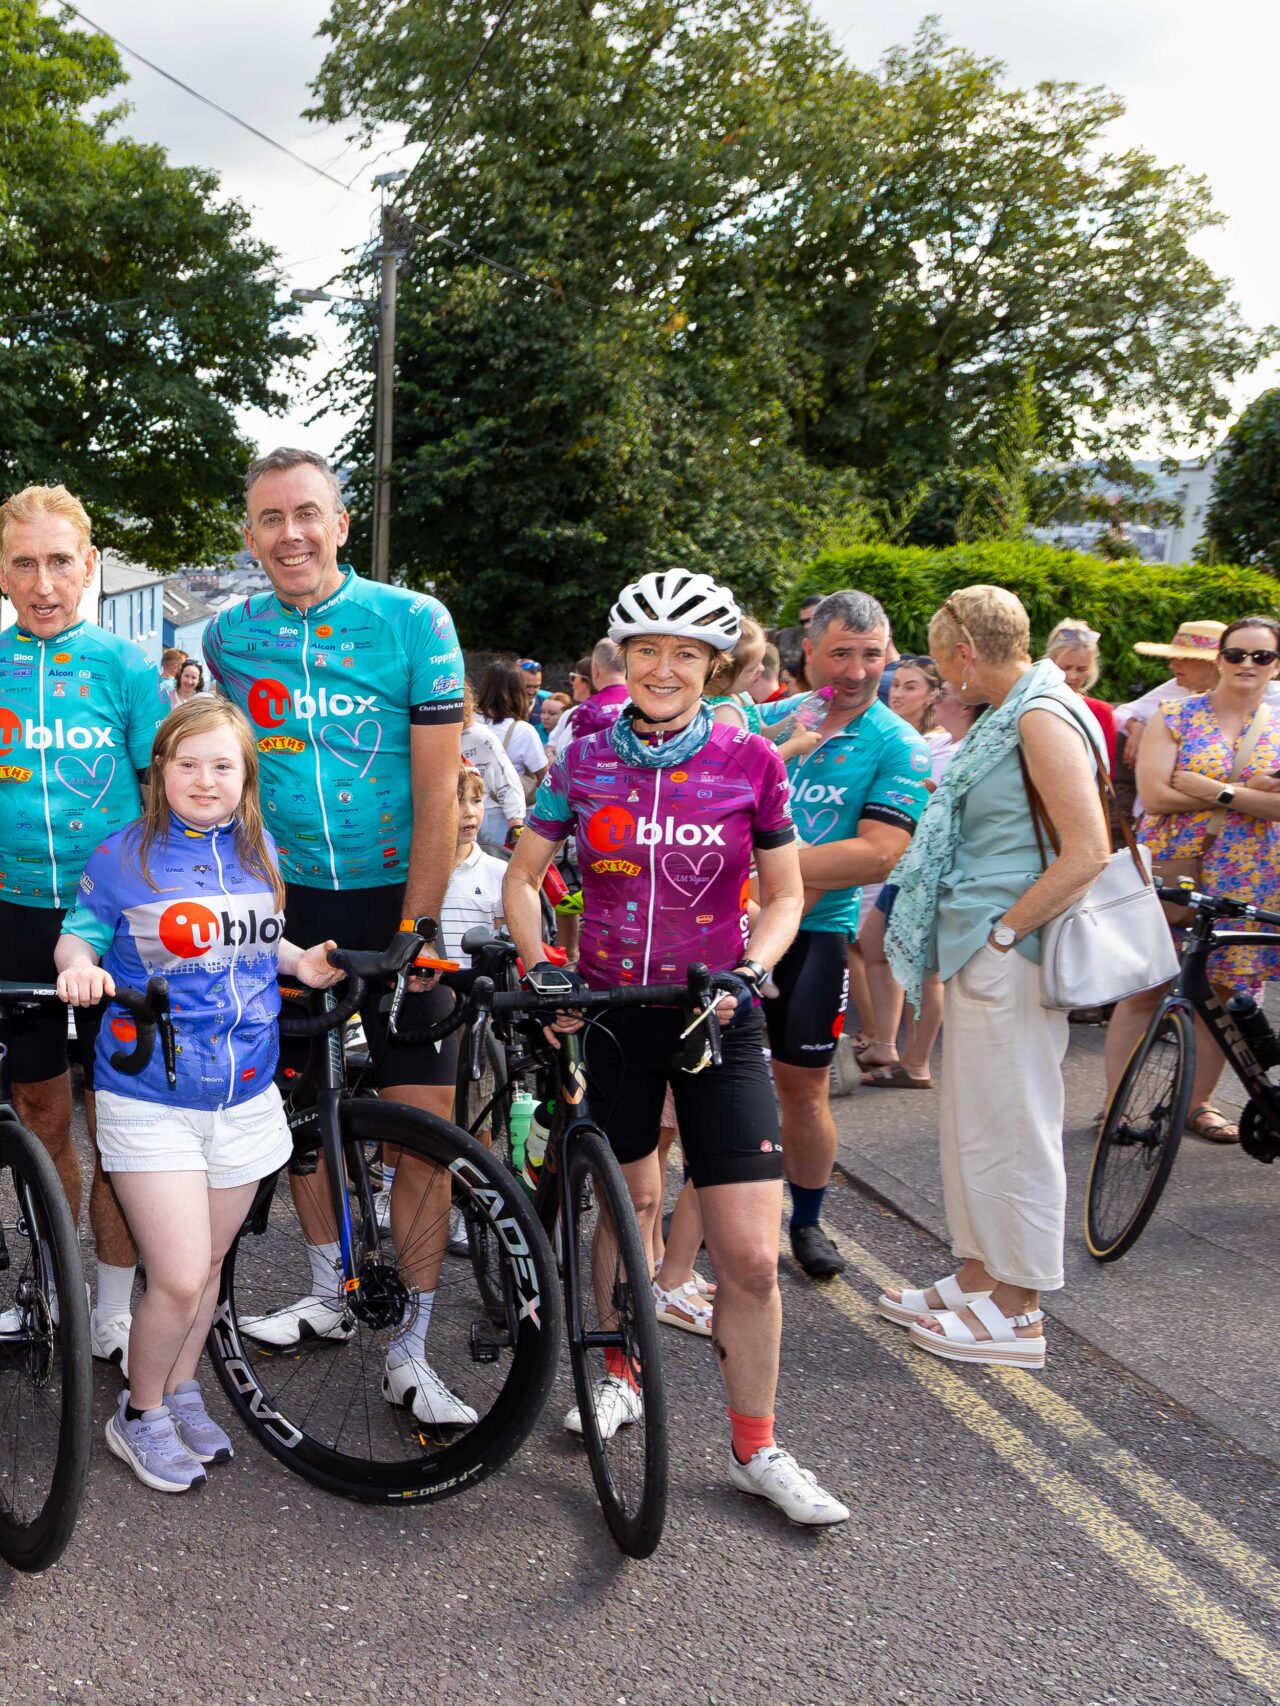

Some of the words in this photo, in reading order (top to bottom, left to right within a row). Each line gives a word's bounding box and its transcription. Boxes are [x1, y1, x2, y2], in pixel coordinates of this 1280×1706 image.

[310, 642, 336, 651] Alcon
[48, 669, 74, 677] Alcon
[419, 704, 436, 712] Chris
[437, 702, 454, 711] Doyle
[257, 736, 306, 753] SMYTHS
[590, 859, 642, 877] SMYTHS
[32, 988, 59, 996] MOST
[287, 1111, 320, 1129] ELLI
[448, 1156, 542, 1332] CADEX
[213, 1298, 304, 1449] CADEX
[419, 1477, 458, 1497] ZERO
